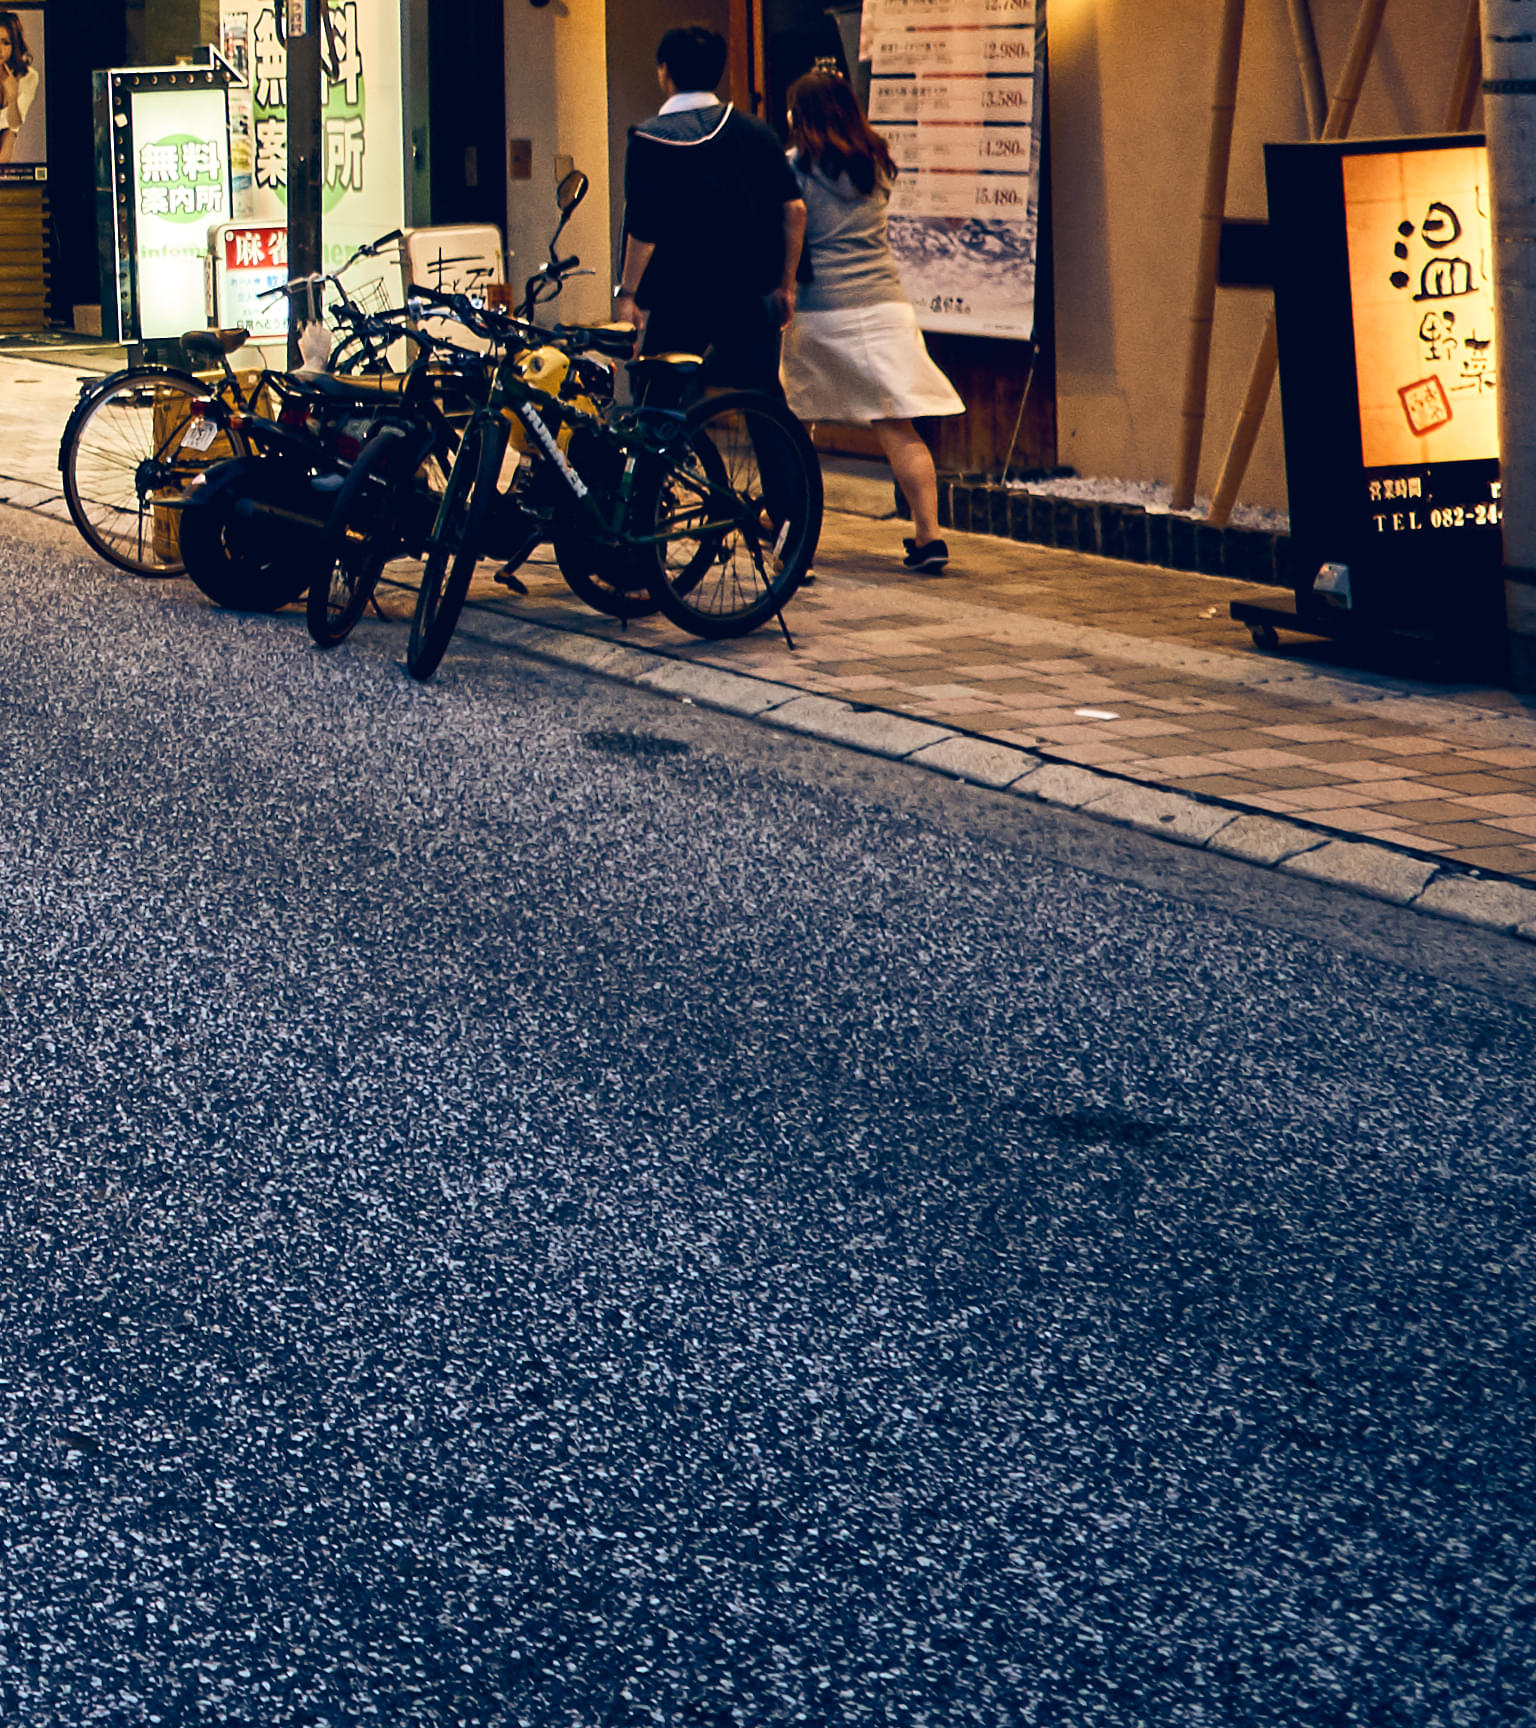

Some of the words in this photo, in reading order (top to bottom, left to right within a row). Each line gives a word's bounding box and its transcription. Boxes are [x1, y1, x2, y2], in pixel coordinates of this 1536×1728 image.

[139, 141, 222, 183] 無料
[254, 114, 365, 192] 案所
[139, 184, 224, 215] 案内所
[1368, 475, 1423, 501] 営業時間
[1373, 510, 1423, 532] TEL
